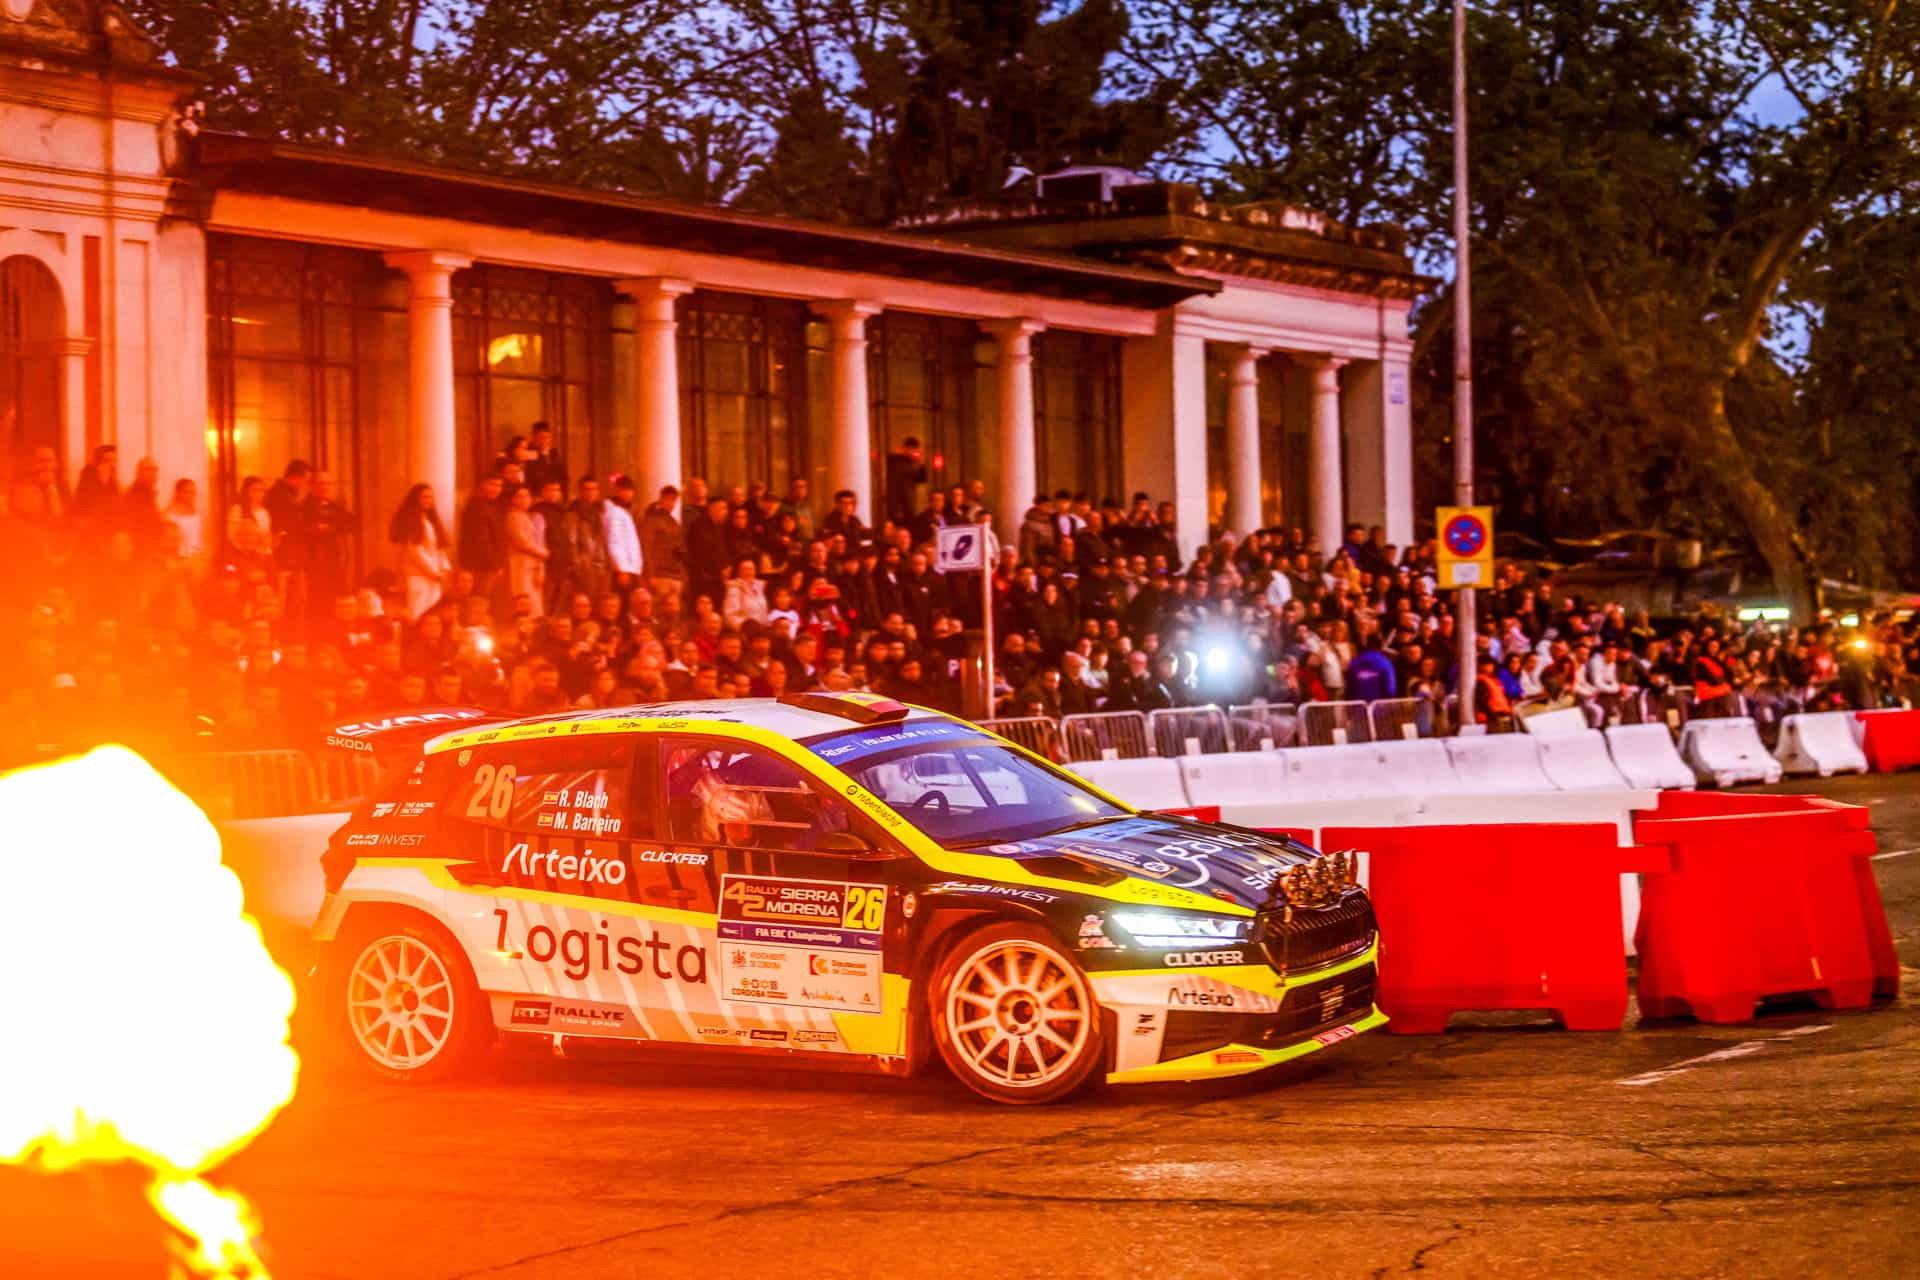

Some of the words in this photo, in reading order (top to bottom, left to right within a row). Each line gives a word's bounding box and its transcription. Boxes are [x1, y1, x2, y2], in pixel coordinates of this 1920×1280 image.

[466, 764, 517, 818] 26
[559, 790, 571, 807] R.
[574, 791, 609, 809] Blach
[554, 812, 569, 829] M.
[572, 811, 622, 833] Barreiro
[501, 843, 627, 885] Arteixo
[640, 850, 709, 866] CLICKFER
[746, 884, 781, 896] RALLY
[780, 887, 840, 903] SIERRA
[989, 886, 1061, 903] INVEST
[766, 901, 839, 917] MORENA
[844, 887, 885, 930] 26
[1164, 950, 1244, 967] CLICKFER
[1168, 987, 1235, 1007] Arteixo
[554, 1006, 625, 1021] RALLYE
